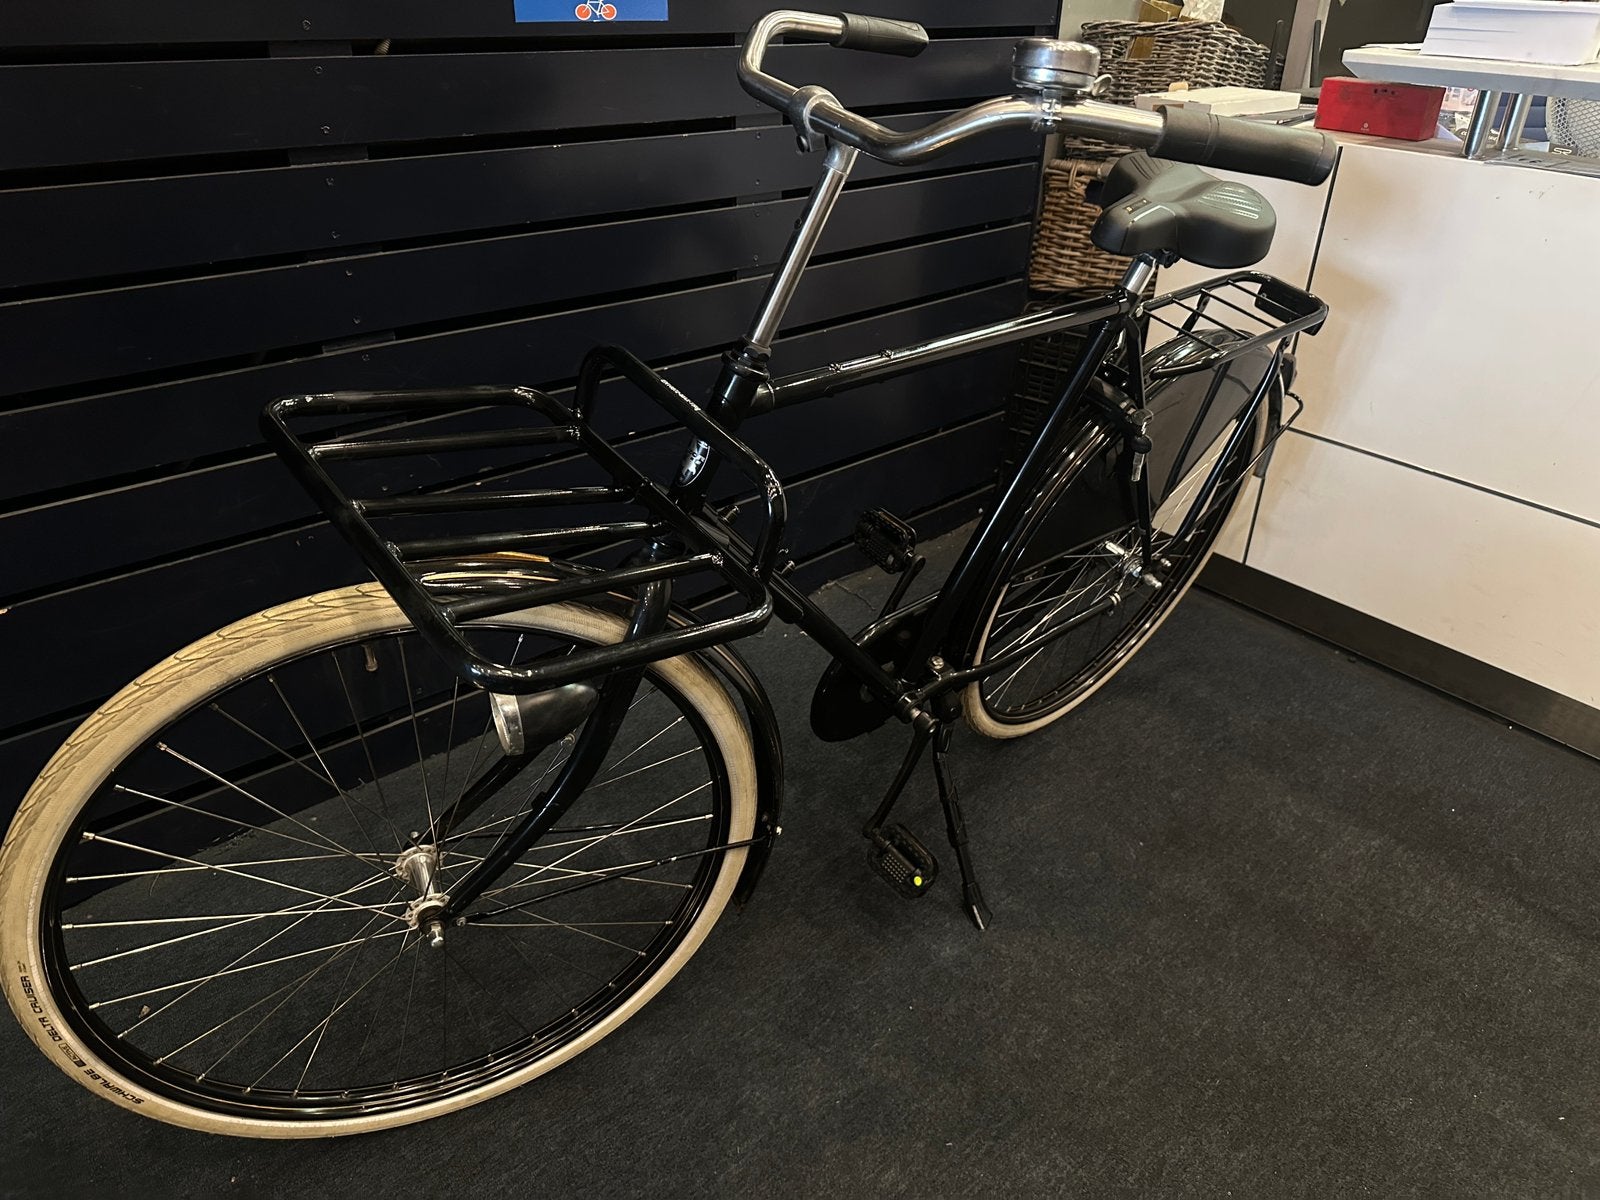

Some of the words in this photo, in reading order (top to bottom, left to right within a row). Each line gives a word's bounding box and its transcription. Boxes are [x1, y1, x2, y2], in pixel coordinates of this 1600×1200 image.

[20, 975, 43, 1014] CRUISER
[38, 1016, 62, 1042] DELTA
[84, 1068, 145, 1105] SCHWALBE
